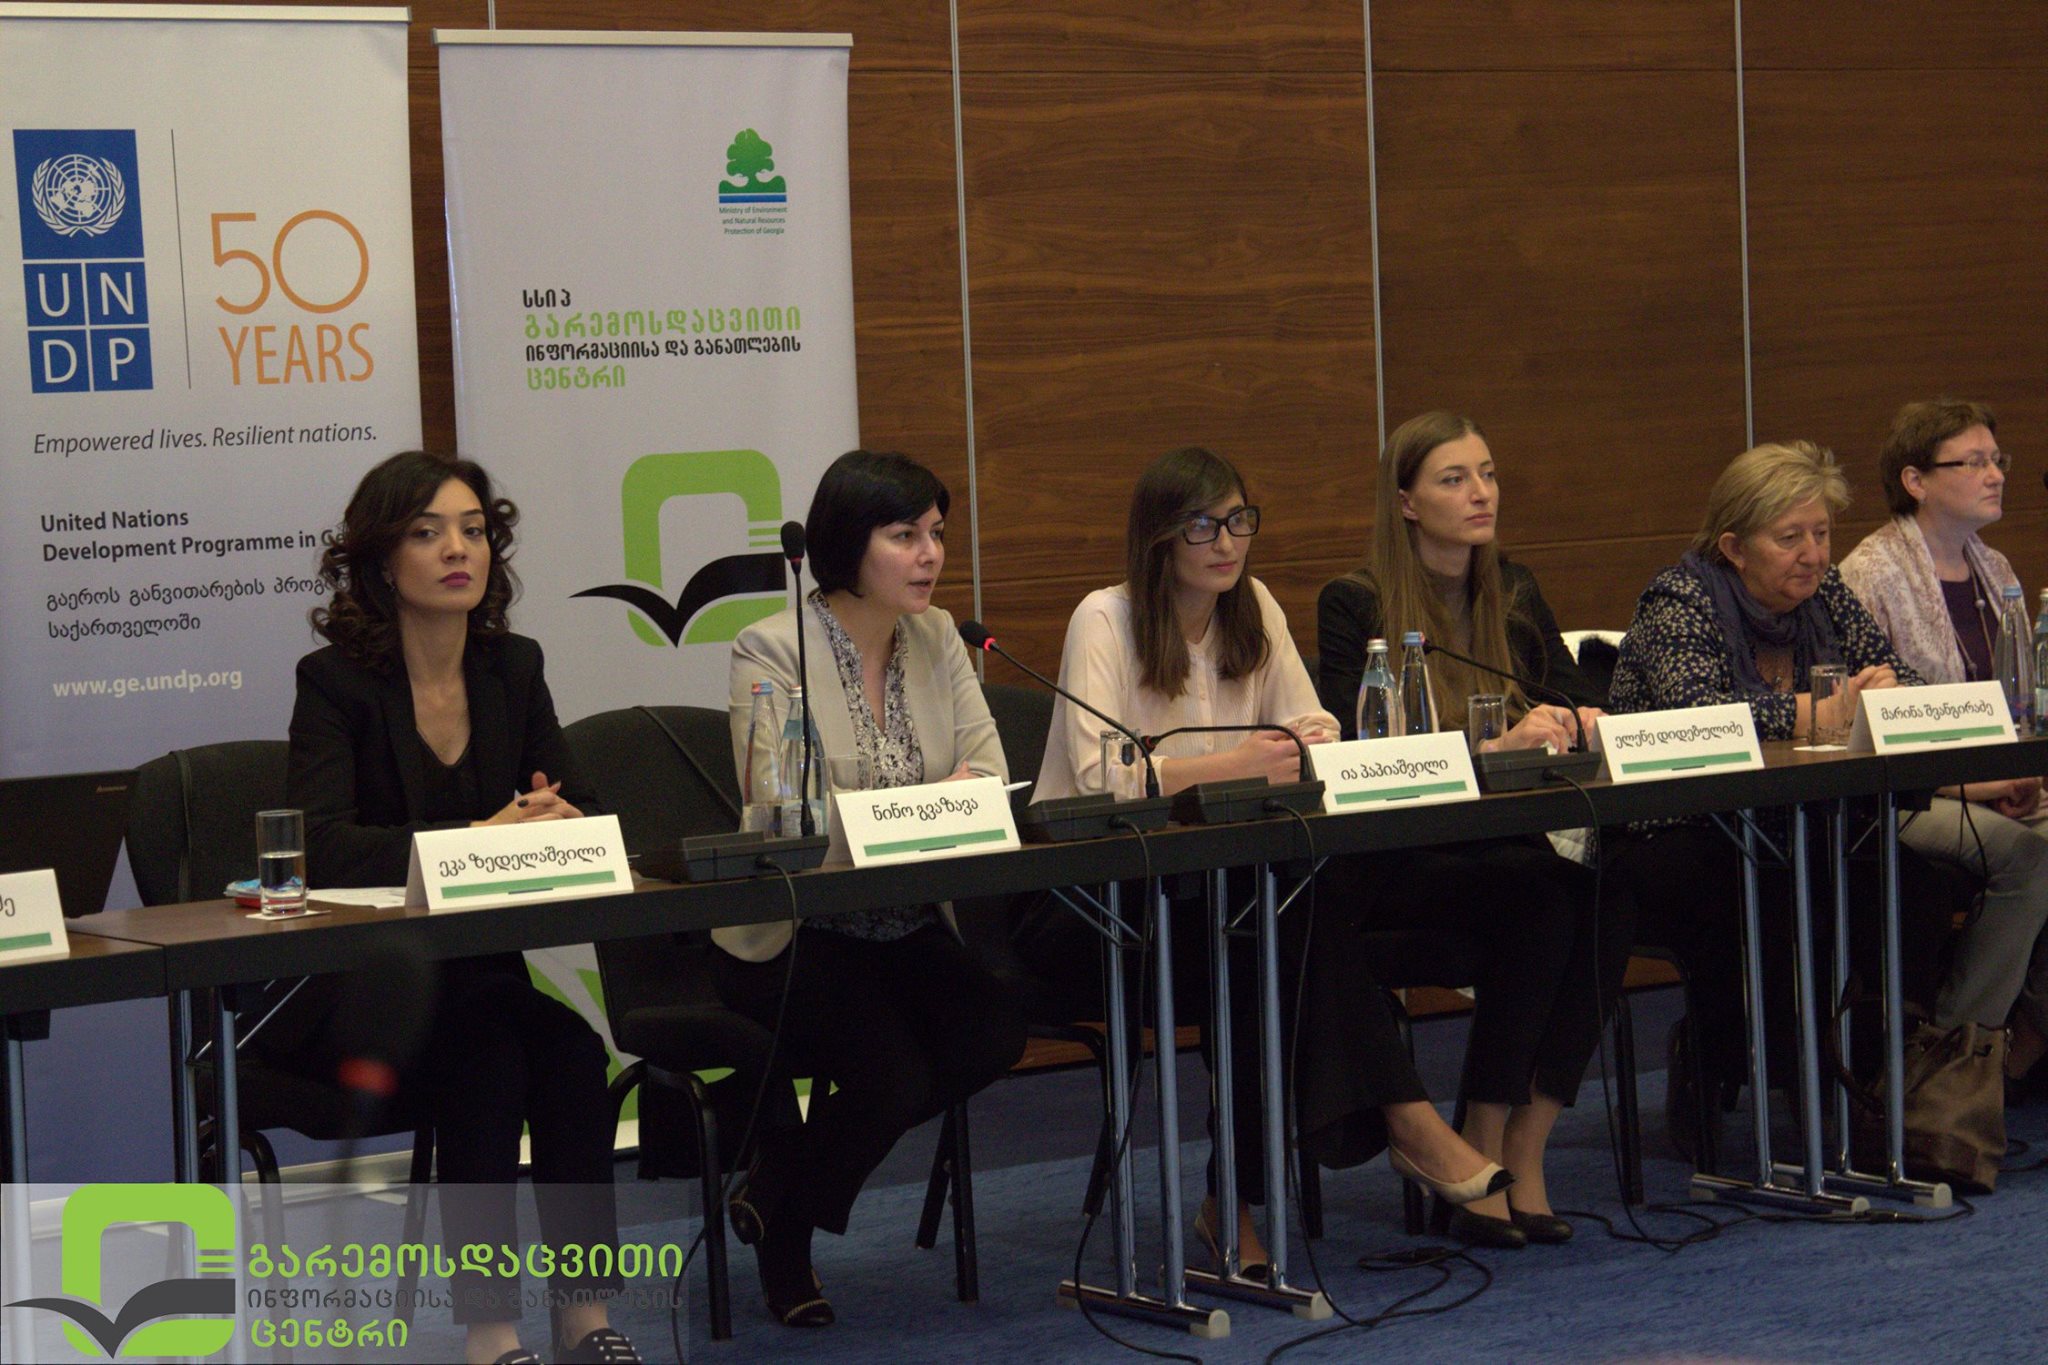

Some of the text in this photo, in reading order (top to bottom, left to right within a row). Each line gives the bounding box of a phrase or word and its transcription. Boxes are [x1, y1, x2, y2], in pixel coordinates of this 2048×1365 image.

[210, 209, 370, 315] 50
[524, 305, 801, 341] გარემოსდაცვითი
[218, 322, 375, 386] YEARS
[525, 336, 802, 362] ინფორმაციისა და განათლების
[526, 364, 626, 391] ცენტრი
[34, 423, 377, 458] Empowered lives. Resilient nations.
[41, 509, 189, 532] United Nations
[43, 538, 176, 563] Development
[182, 531, 294, 557] Programme
[299, 530, 316, 548] in
[46, 588, 120, 612] გაეროს
[129, 577, 265, 608] განვითარების
[48, 612, 201, 642] საქართველოში
[53, 668, 243, 699] www.ge.undp.org
[1881, 704, 1924, 721] მარინა
[1615, 720, 1744, 749] ელენე დიდებულიძე
[1341, 758, 1449, 780] ია პაპიაშვილი
[872, 796, 979, 822] ნინო გვაზავა
[439, 845, 607, 877] ეკა ზედელაშვილი
